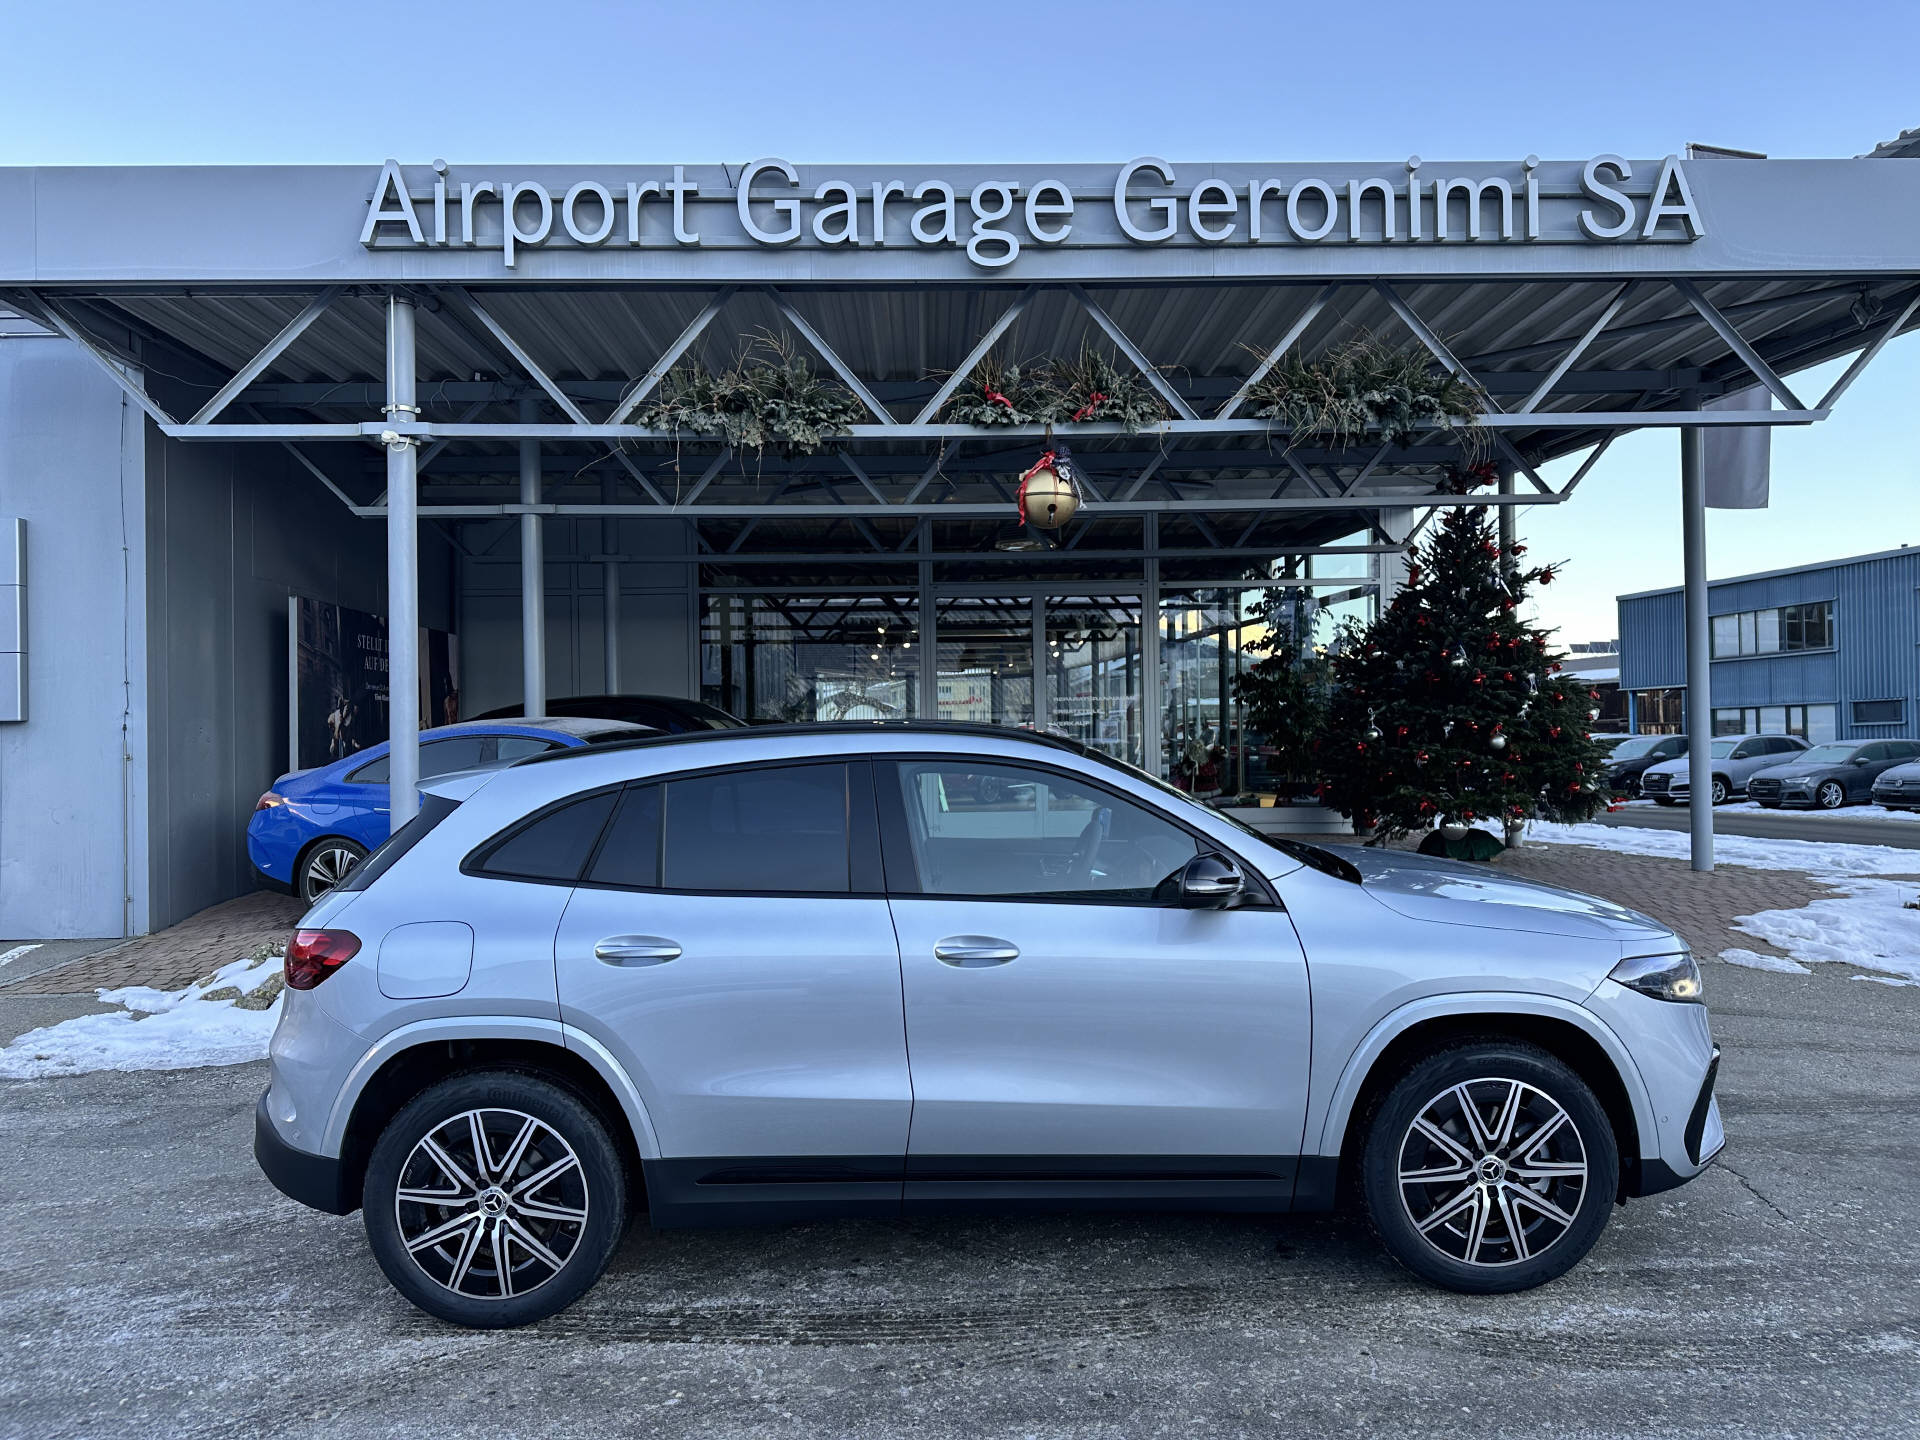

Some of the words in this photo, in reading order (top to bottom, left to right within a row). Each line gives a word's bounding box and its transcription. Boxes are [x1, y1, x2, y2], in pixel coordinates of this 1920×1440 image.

[360, 158, 700, 269] Airport
[736, 157, 1075, 269] Garage
[1113, 155, 1539, 244] Geronimi
[1577, 154, 1705, 243] SA
[357, 634, 382, 651] STELLT
[364, 655, 378, 671] AUF
